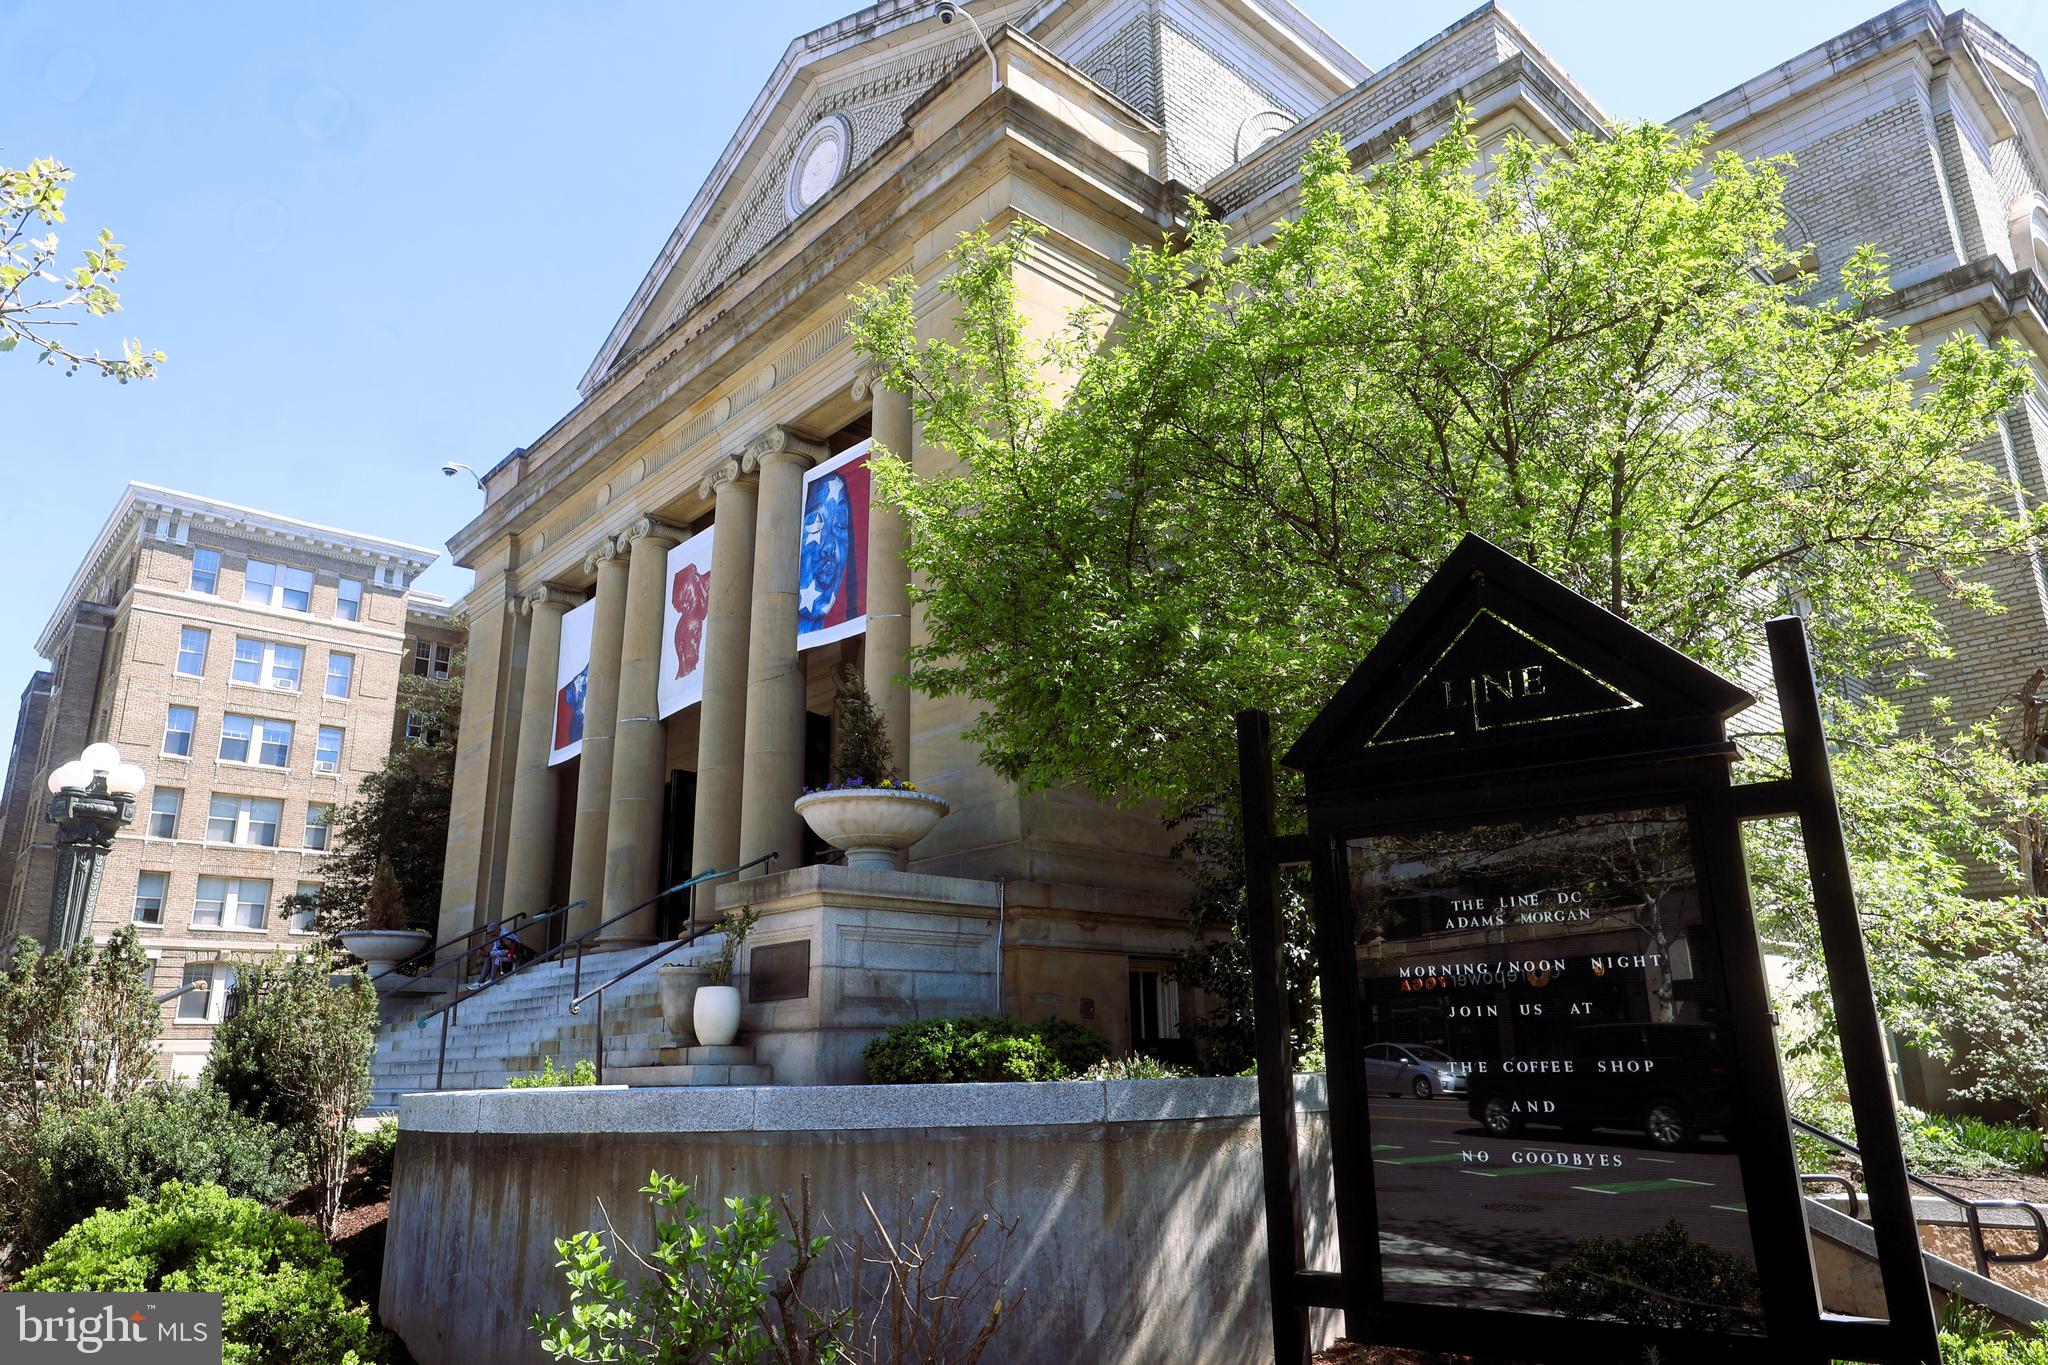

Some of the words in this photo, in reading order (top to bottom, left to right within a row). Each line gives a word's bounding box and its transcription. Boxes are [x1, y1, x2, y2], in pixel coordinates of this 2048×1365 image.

[1442, 665, 1546, 732] LINE
[1451, 898, 1484, 912] THE
[1500, 893, 1539, 908] LINE
[1557, 891, 1582, 904] DC
[1445, 914, 1504, 930] ADAMS
[1520, 908, 1591, 925] MORGAN
[1591, 954, 1662, 970] NIGHT
[1449, 1004, 1498, 1018] JOIN
[1519, 1003, 1543, 1016] US
[1570, 1002, 1594, 1015] AT
[1447, 1060, 1487, 1074] THE
[1502, 1060, 1574, 1073] COFFEE
[1598, 1060, 1655, 1073] SHOP
[1511, 1100, 1556, 1113] AND
[1461, 1150, 1489, 1163] NO
[1511, 1151, 1623, 1167] GOODBYES
